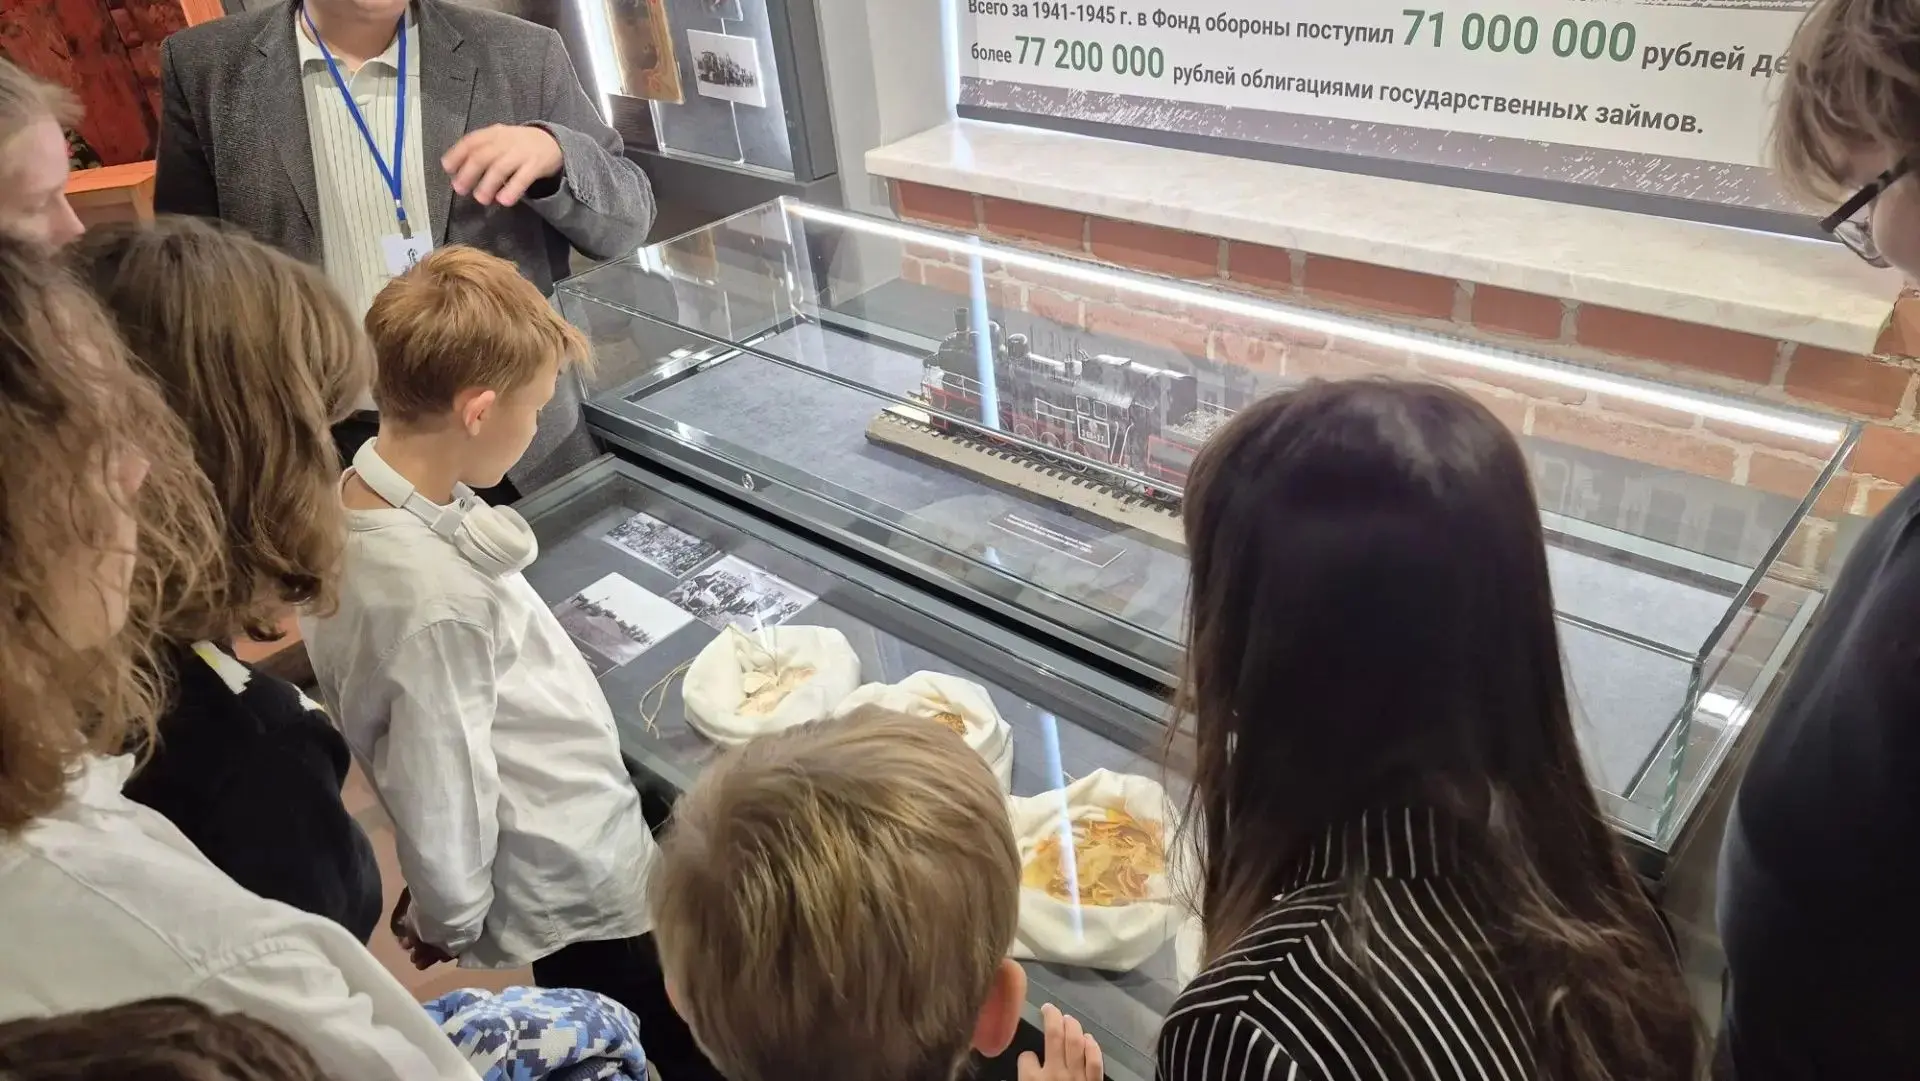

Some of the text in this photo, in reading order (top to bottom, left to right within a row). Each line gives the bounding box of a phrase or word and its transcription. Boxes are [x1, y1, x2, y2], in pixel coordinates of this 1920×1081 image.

[968, 0, 1791, 78] Всего за 1941-1945 г. в Фонд обороны поступил 71 000 000 рублей де
[970, 35, 1704, 134] более 77 200 000 рублей облигациями государственных займов.
